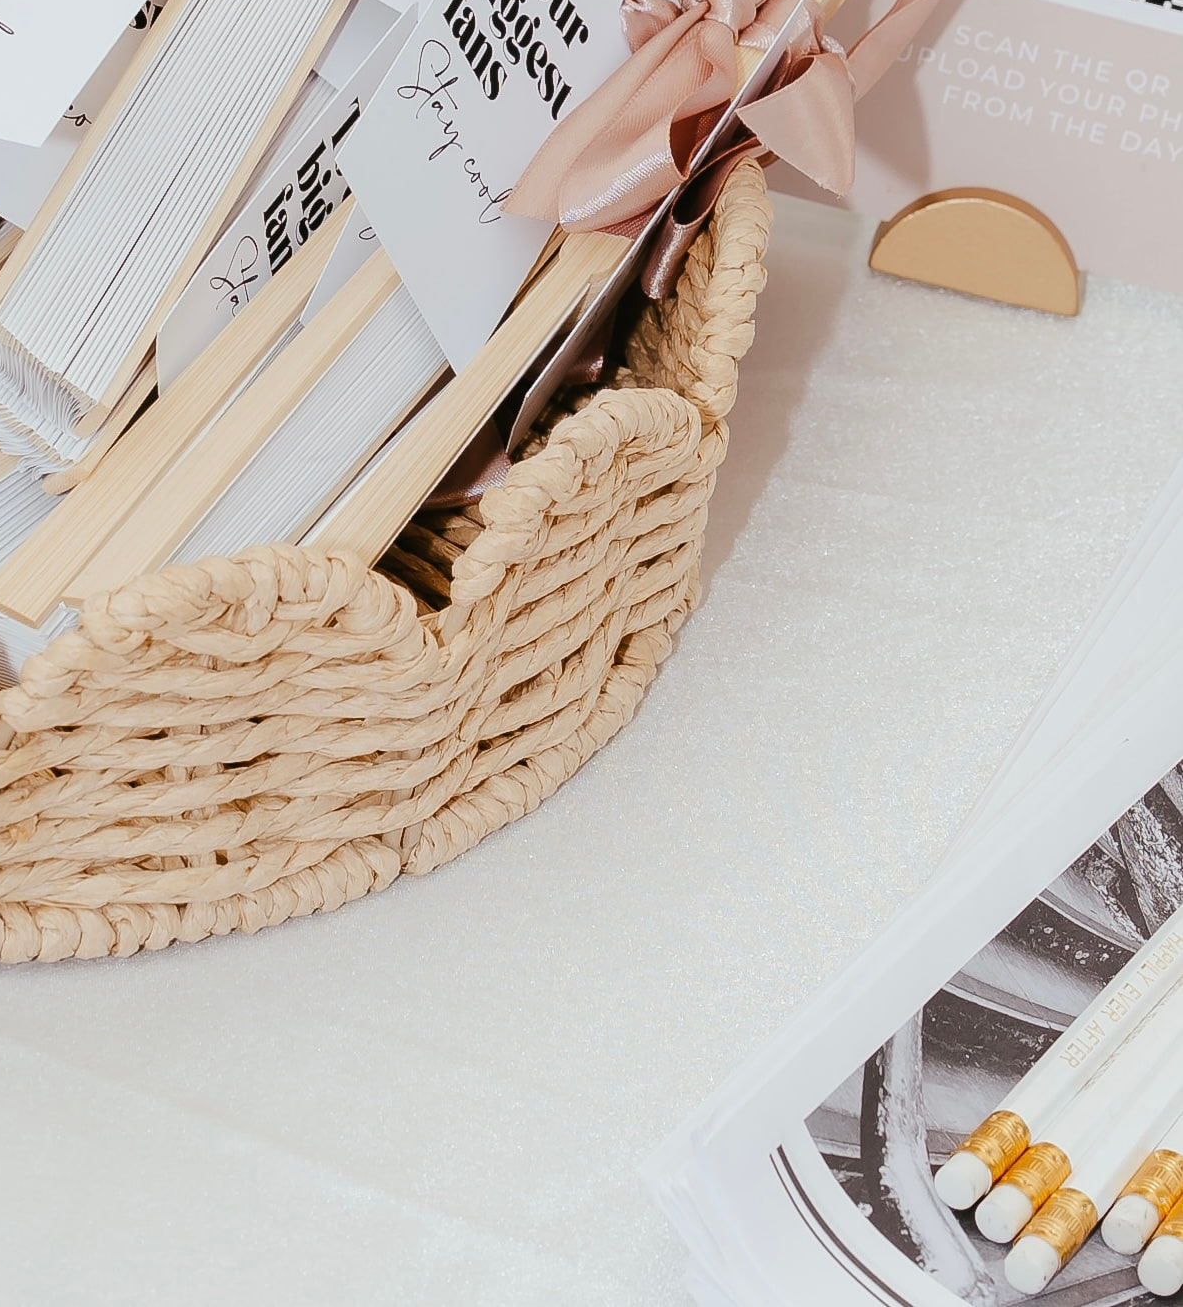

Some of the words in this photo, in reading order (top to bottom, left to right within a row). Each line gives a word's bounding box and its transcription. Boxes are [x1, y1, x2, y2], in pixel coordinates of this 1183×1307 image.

[898, 44, 1026, 91] UPLOAD
[1040, 77, 1127, 117] YOUR
[954, 25, 1040, 64] SCAN
[1053, 47, 1114, 84] THE
[1125, 68, 1170, 98] QR
[397, 38, 463, 161] Stay
[462, 157, 514, 225] cool
[942, 84, 1034, 126] FROM
[1048, 110, 1109, 146] THE
[1120, 129, 1183, 162] DAY
[263, 183, 294, 277] fan
[1136, 931, 1183, 988] HAPPILY
[1100, 982, 1143, 1023] EVER
[1059, 1019, 1106, 1069] AFTER
